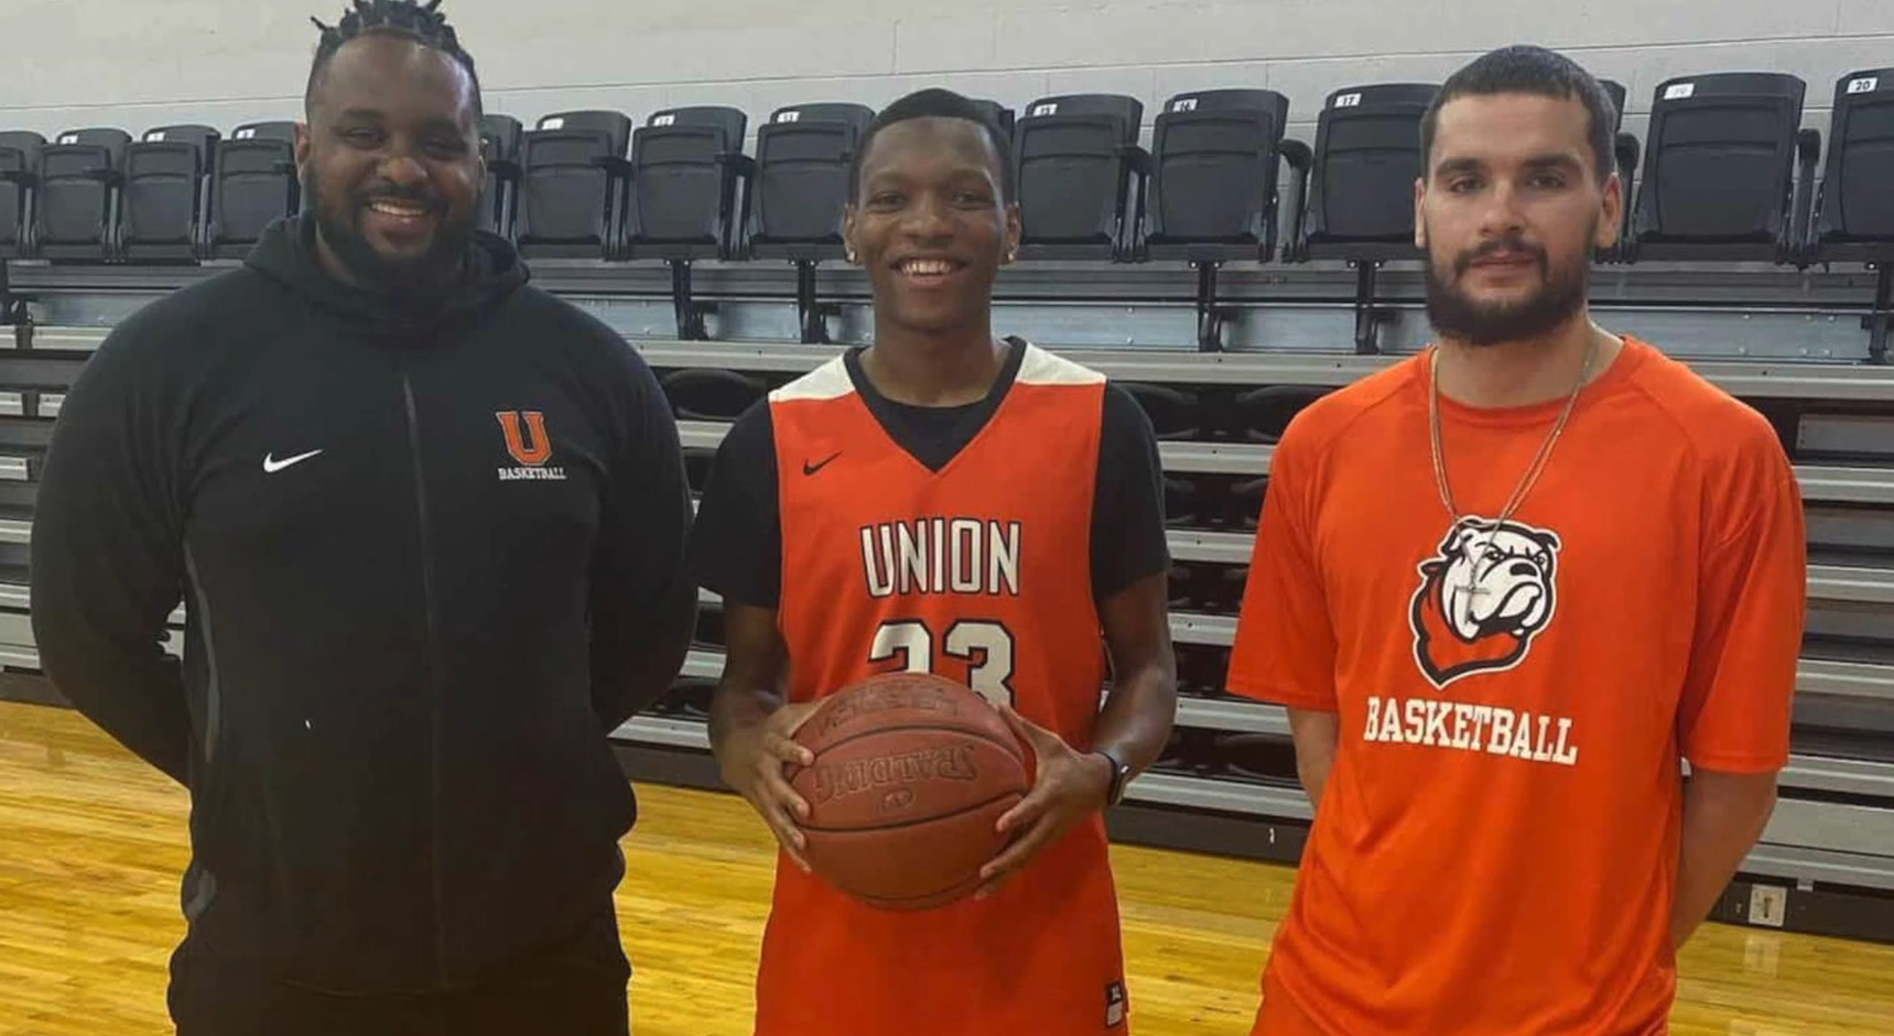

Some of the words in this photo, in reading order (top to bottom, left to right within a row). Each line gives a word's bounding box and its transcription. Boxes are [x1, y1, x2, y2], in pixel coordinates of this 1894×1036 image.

[1856, 80, 1871, 91] 20
[496, 411, 552, 466] U
[498, 467, 566, 480] BASKETBALL
[860, 517, 1021, 598] UNION
[1363, 696, 1578, 765] BASKETBALL
[814, 744, 978, 803] SPALDING
